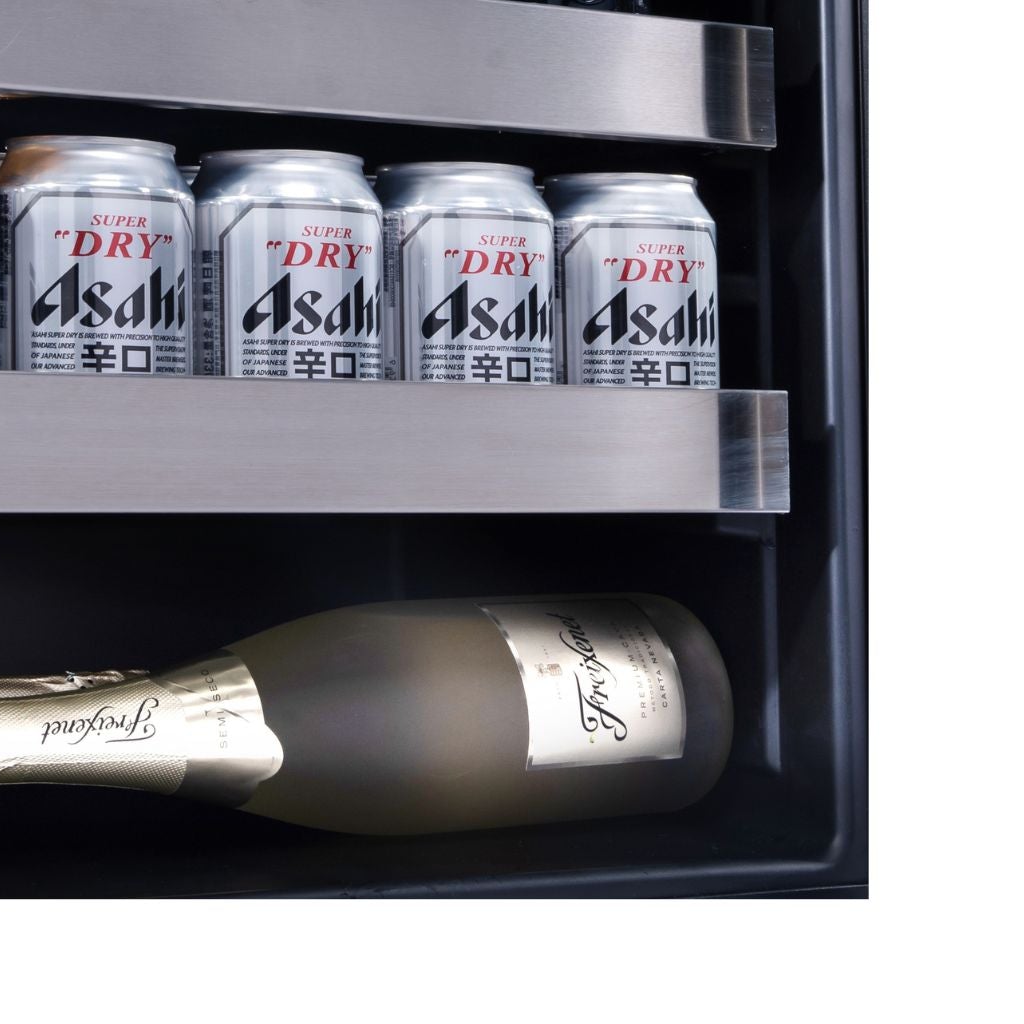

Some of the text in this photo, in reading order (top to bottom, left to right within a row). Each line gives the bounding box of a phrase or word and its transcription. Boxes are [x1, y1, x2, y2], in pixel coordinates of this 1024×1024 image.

[91, 214, 147, 228] SUPER
[302, 226, 352, 239] SUPER
[478, 234, 526, 247] SUPER
[637, 243, 685, 255] SUPER
[31, 262, 185, 330] Asahi
[242, 272, 380, 337] Asahi
[422, 279, 553, 343] Asahi
[582, 287, 715, 347] Asahi
[41, 352, 75, 360] JAPANESE
[81, 341, 152, 373] 辛口
[293, 348, 356, 379] 辛口
[471, 353, 531, 382] 辛口
[630, 358, 690, 386] 辛口
[256, 369, 288, 377] ADVANCED
[545, 612, 628, 742] Freixenet
[628, 653, 647, 719] PREMIUM
[656, 669, 668, 708] CARTA
[41, 697, 159, 744] Freixenet
[201, 668, 229, 750] SEMI SECO
